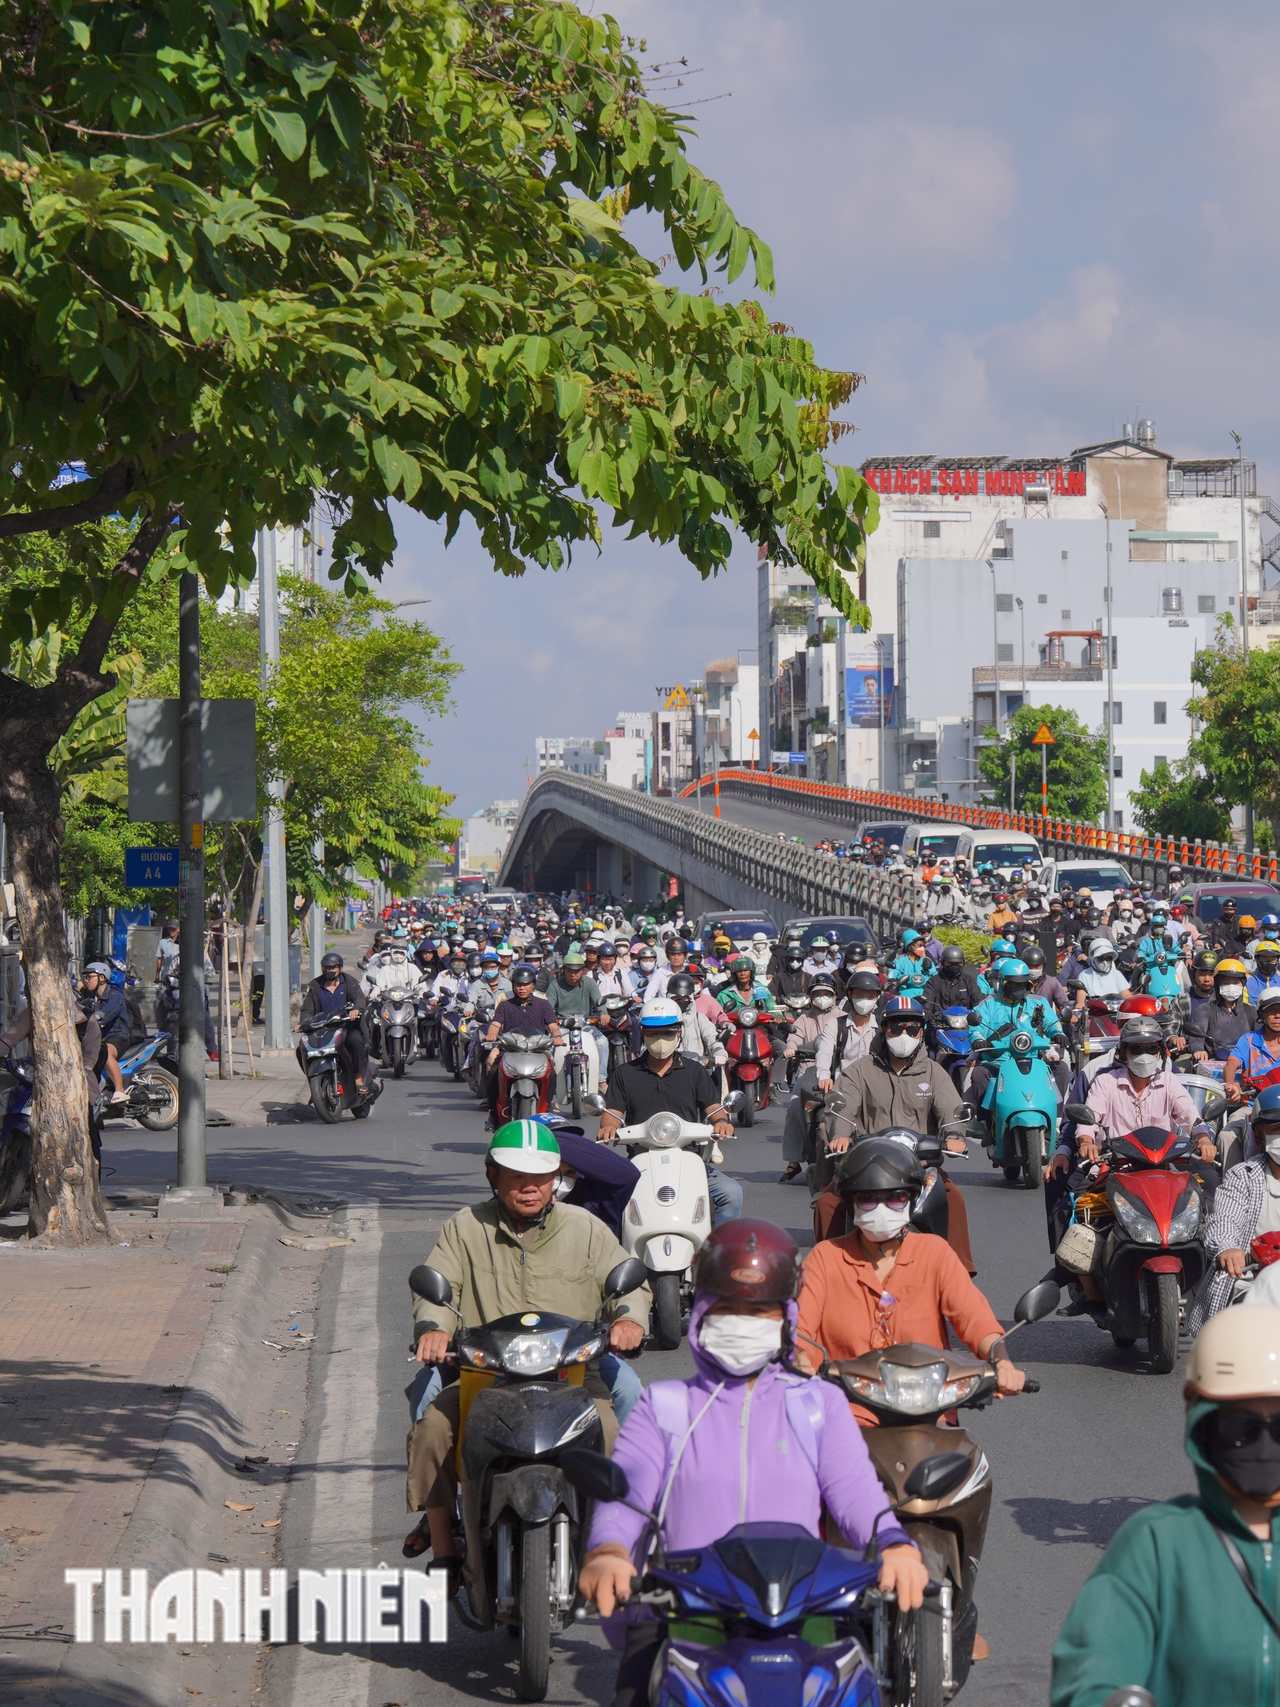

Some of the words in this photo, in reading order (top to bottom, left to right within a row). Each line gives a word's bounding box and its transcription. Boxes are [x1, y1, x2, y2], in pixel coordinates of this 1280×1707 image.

[864, 464, 931, 495] KHÁCH
[938, 470, 979, 500] SẠN
[985, 470, 1037, 496] MINH
[1044, 466, 1085, 496] TÂM
[140, 850, 172, 862] ĐƯỜNG
[519, 1385, 549, 1393] HONDA
